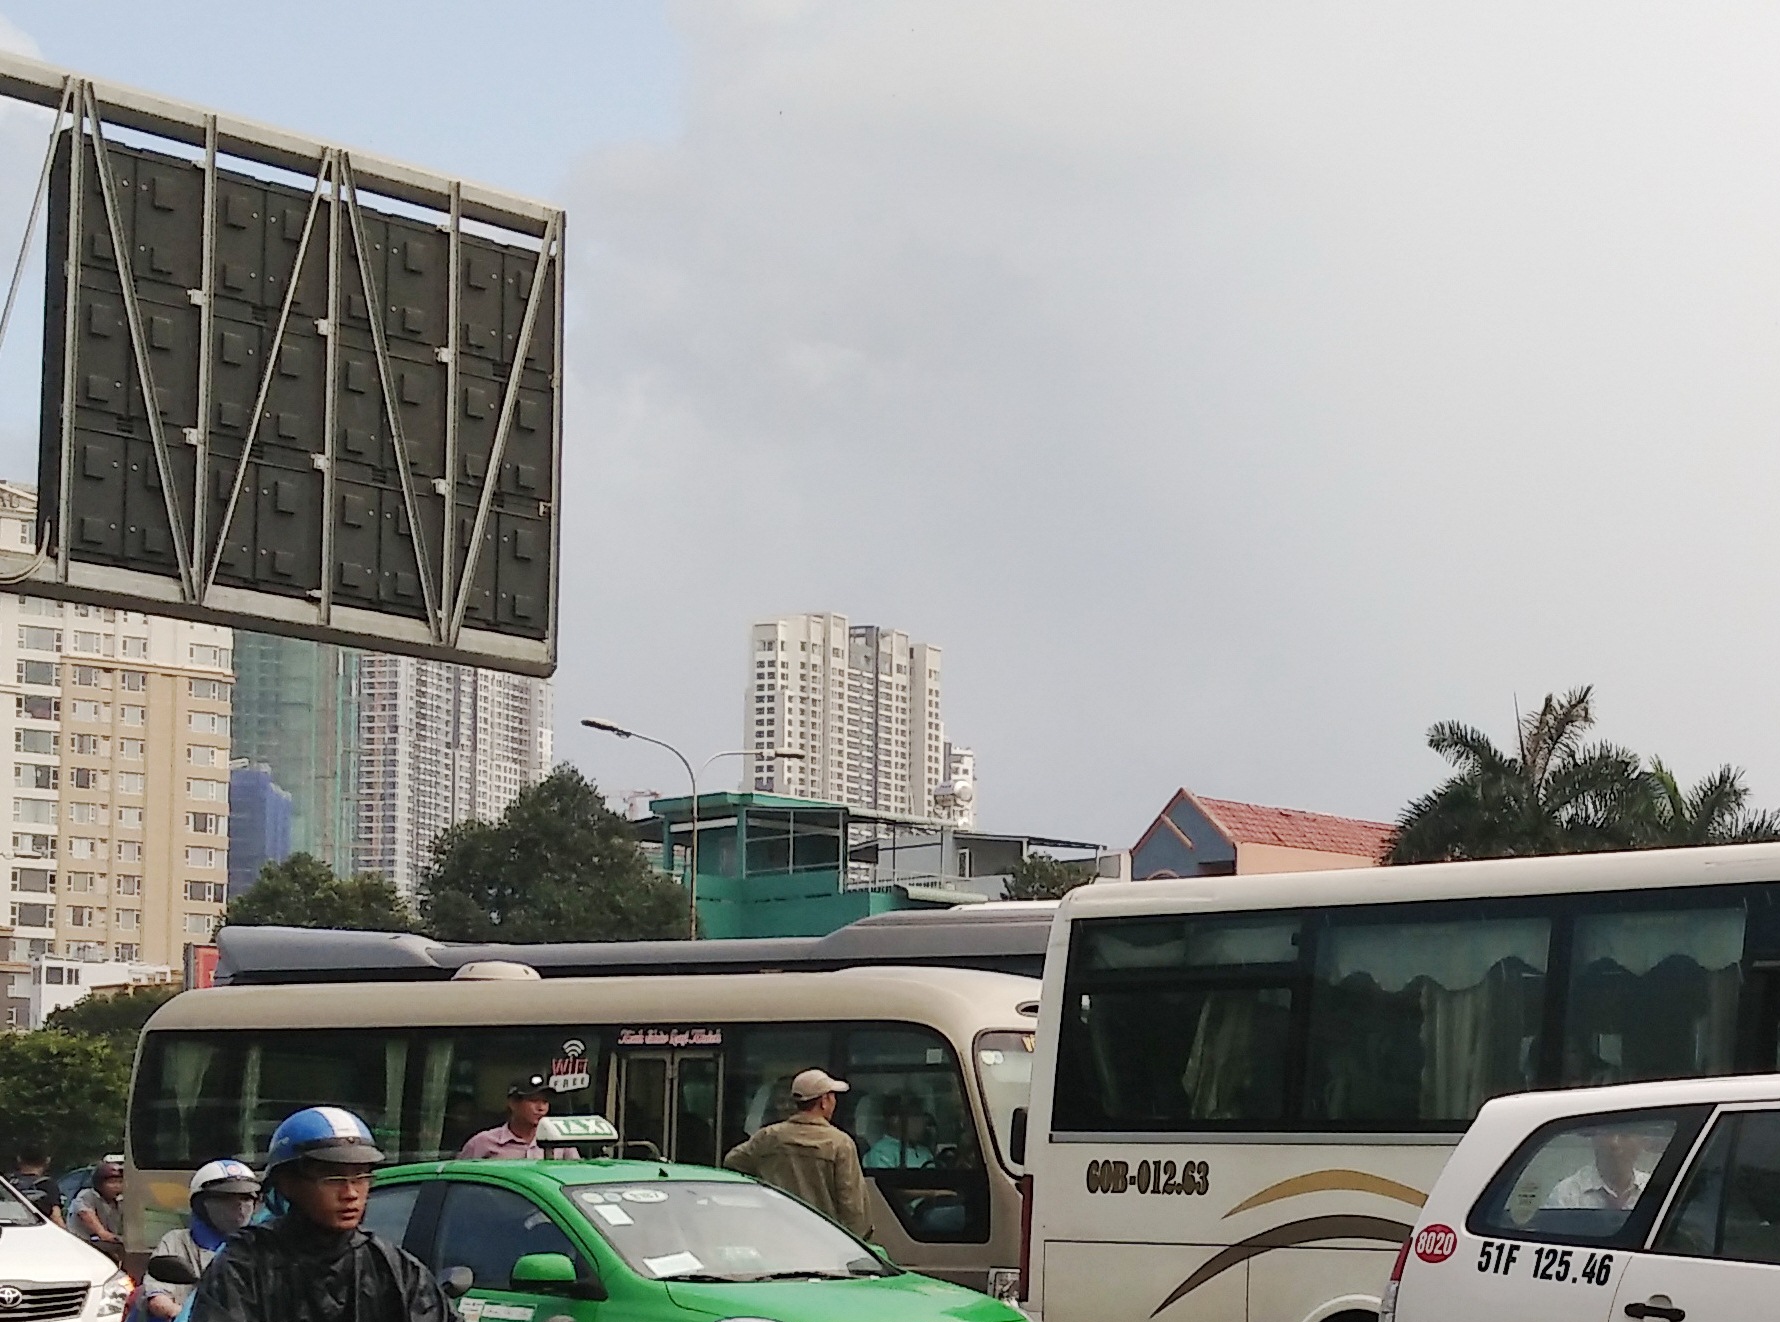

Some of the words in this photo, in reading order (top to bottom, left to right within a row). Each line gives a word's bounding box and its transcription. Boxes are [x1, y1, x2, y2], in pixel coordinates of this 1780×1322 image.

[551, 1119, 613, 1135] TAXI
[1086, 1159, 1210, 1195] 60B-012.63
[1417, 1231, 1452, 1256] 8020
[1477, 1241, 1521, 1276] 51F
[1532, 1247, 1614, 1286] 125.46
